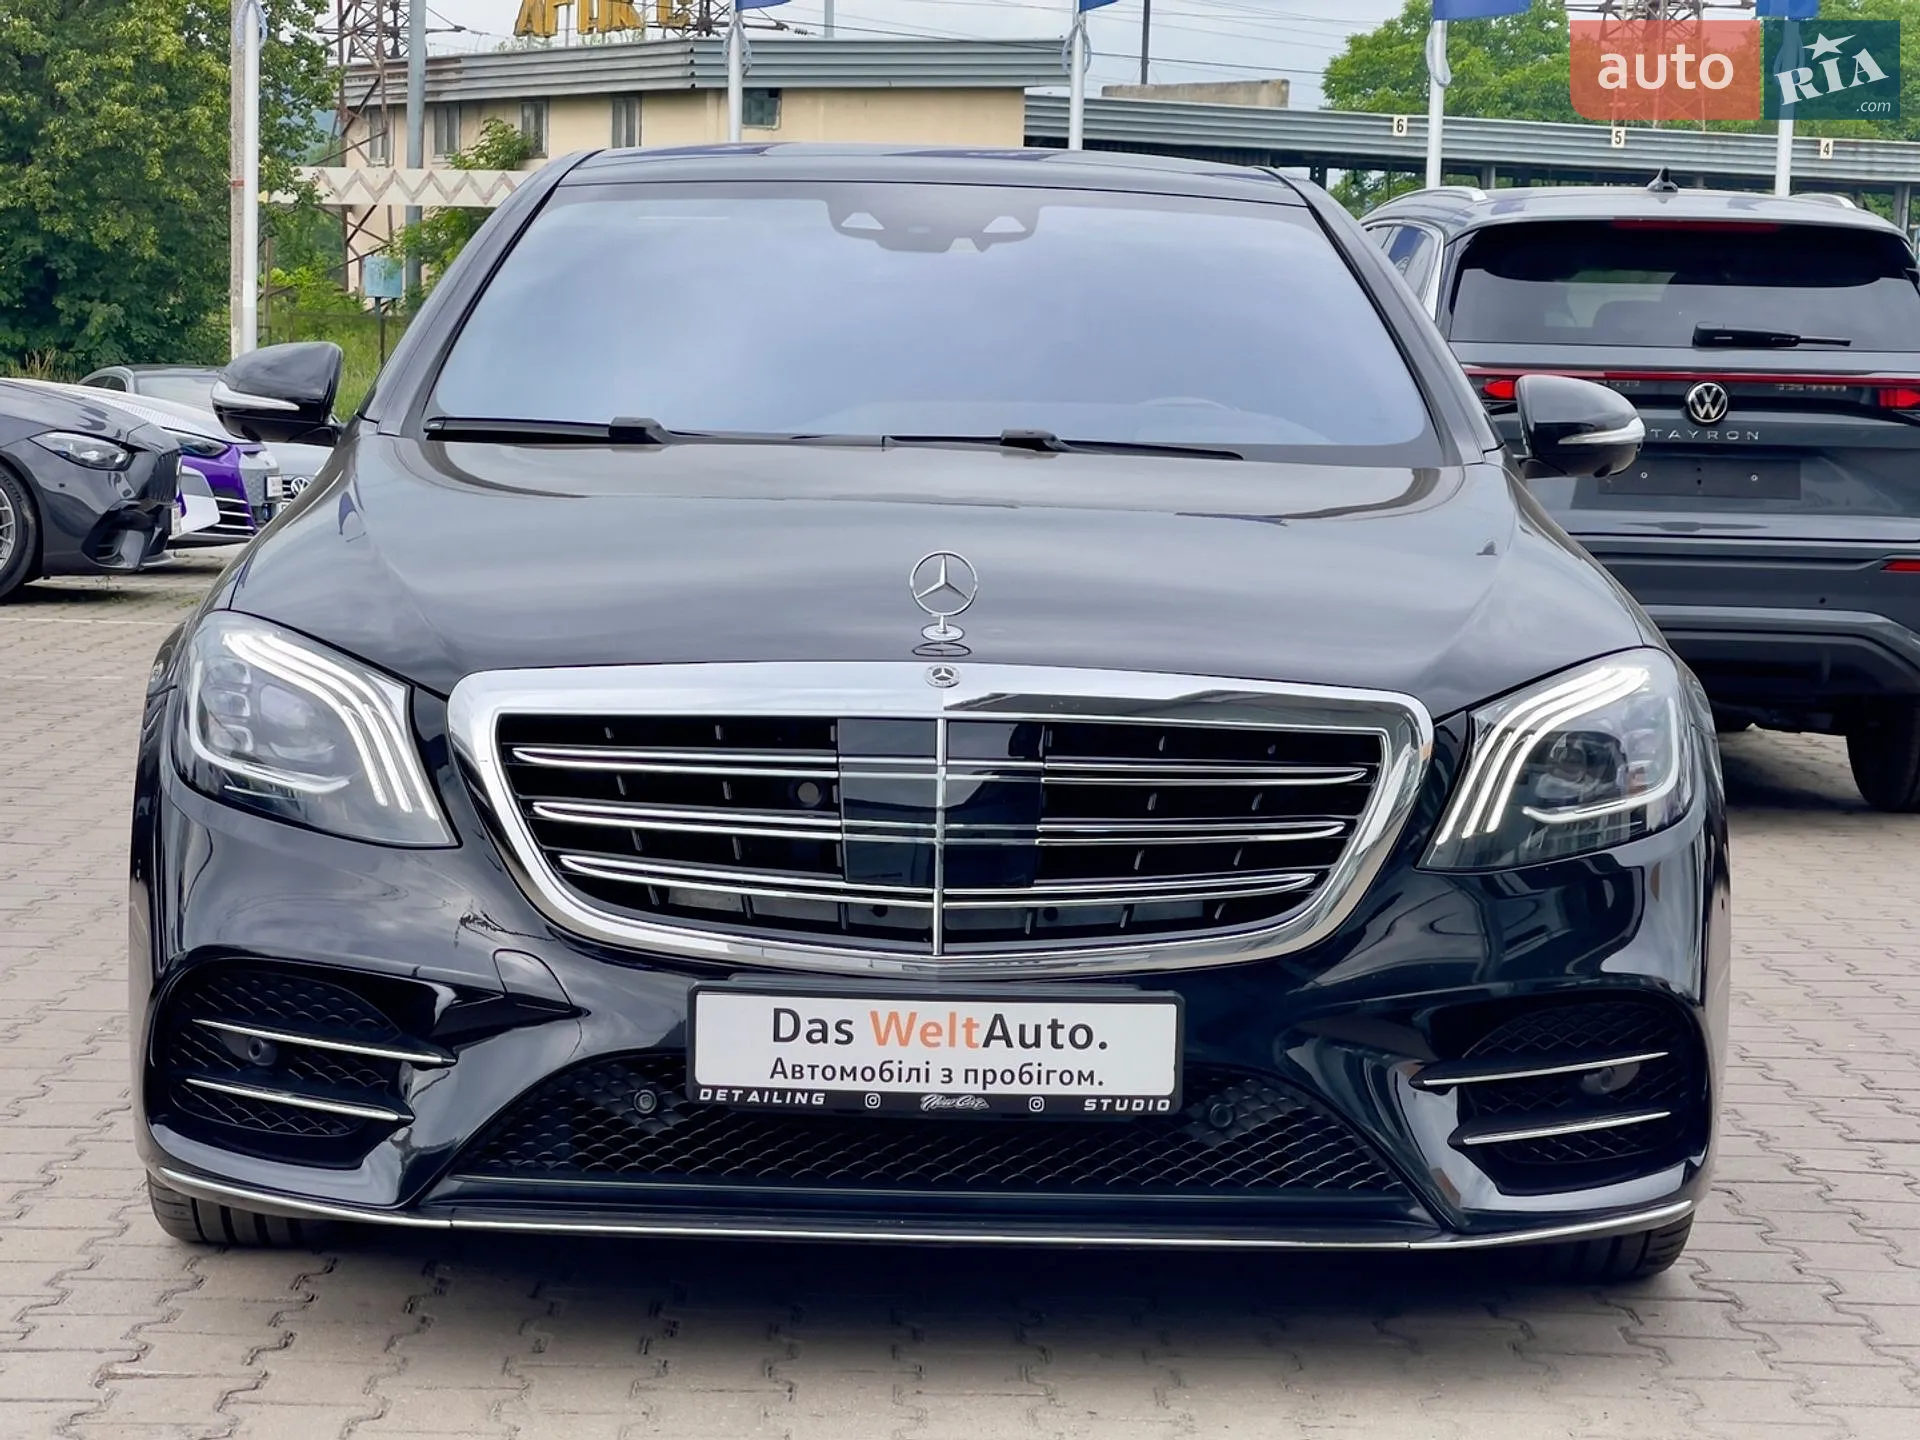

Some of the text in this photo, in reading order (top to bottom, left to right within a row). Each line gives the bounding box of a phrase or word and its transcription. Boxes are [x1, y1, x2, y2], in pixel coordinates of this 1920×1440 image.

[1396, 118, 1405, 133] 6
[1613, 131, 1623, 145] 5
[1823, 142, 1831, 156] 4
[1650, 429, 1760, 441] TAYRON
[772, 1007, 1109, 1051] Das WeltAuto.
[769, 1056, 1105, 1091] Автомобілі з пробігом.
[699, 1087, 826, 1106] DETAILING
[1083, 1098, 1171, 1112] STUDIO
